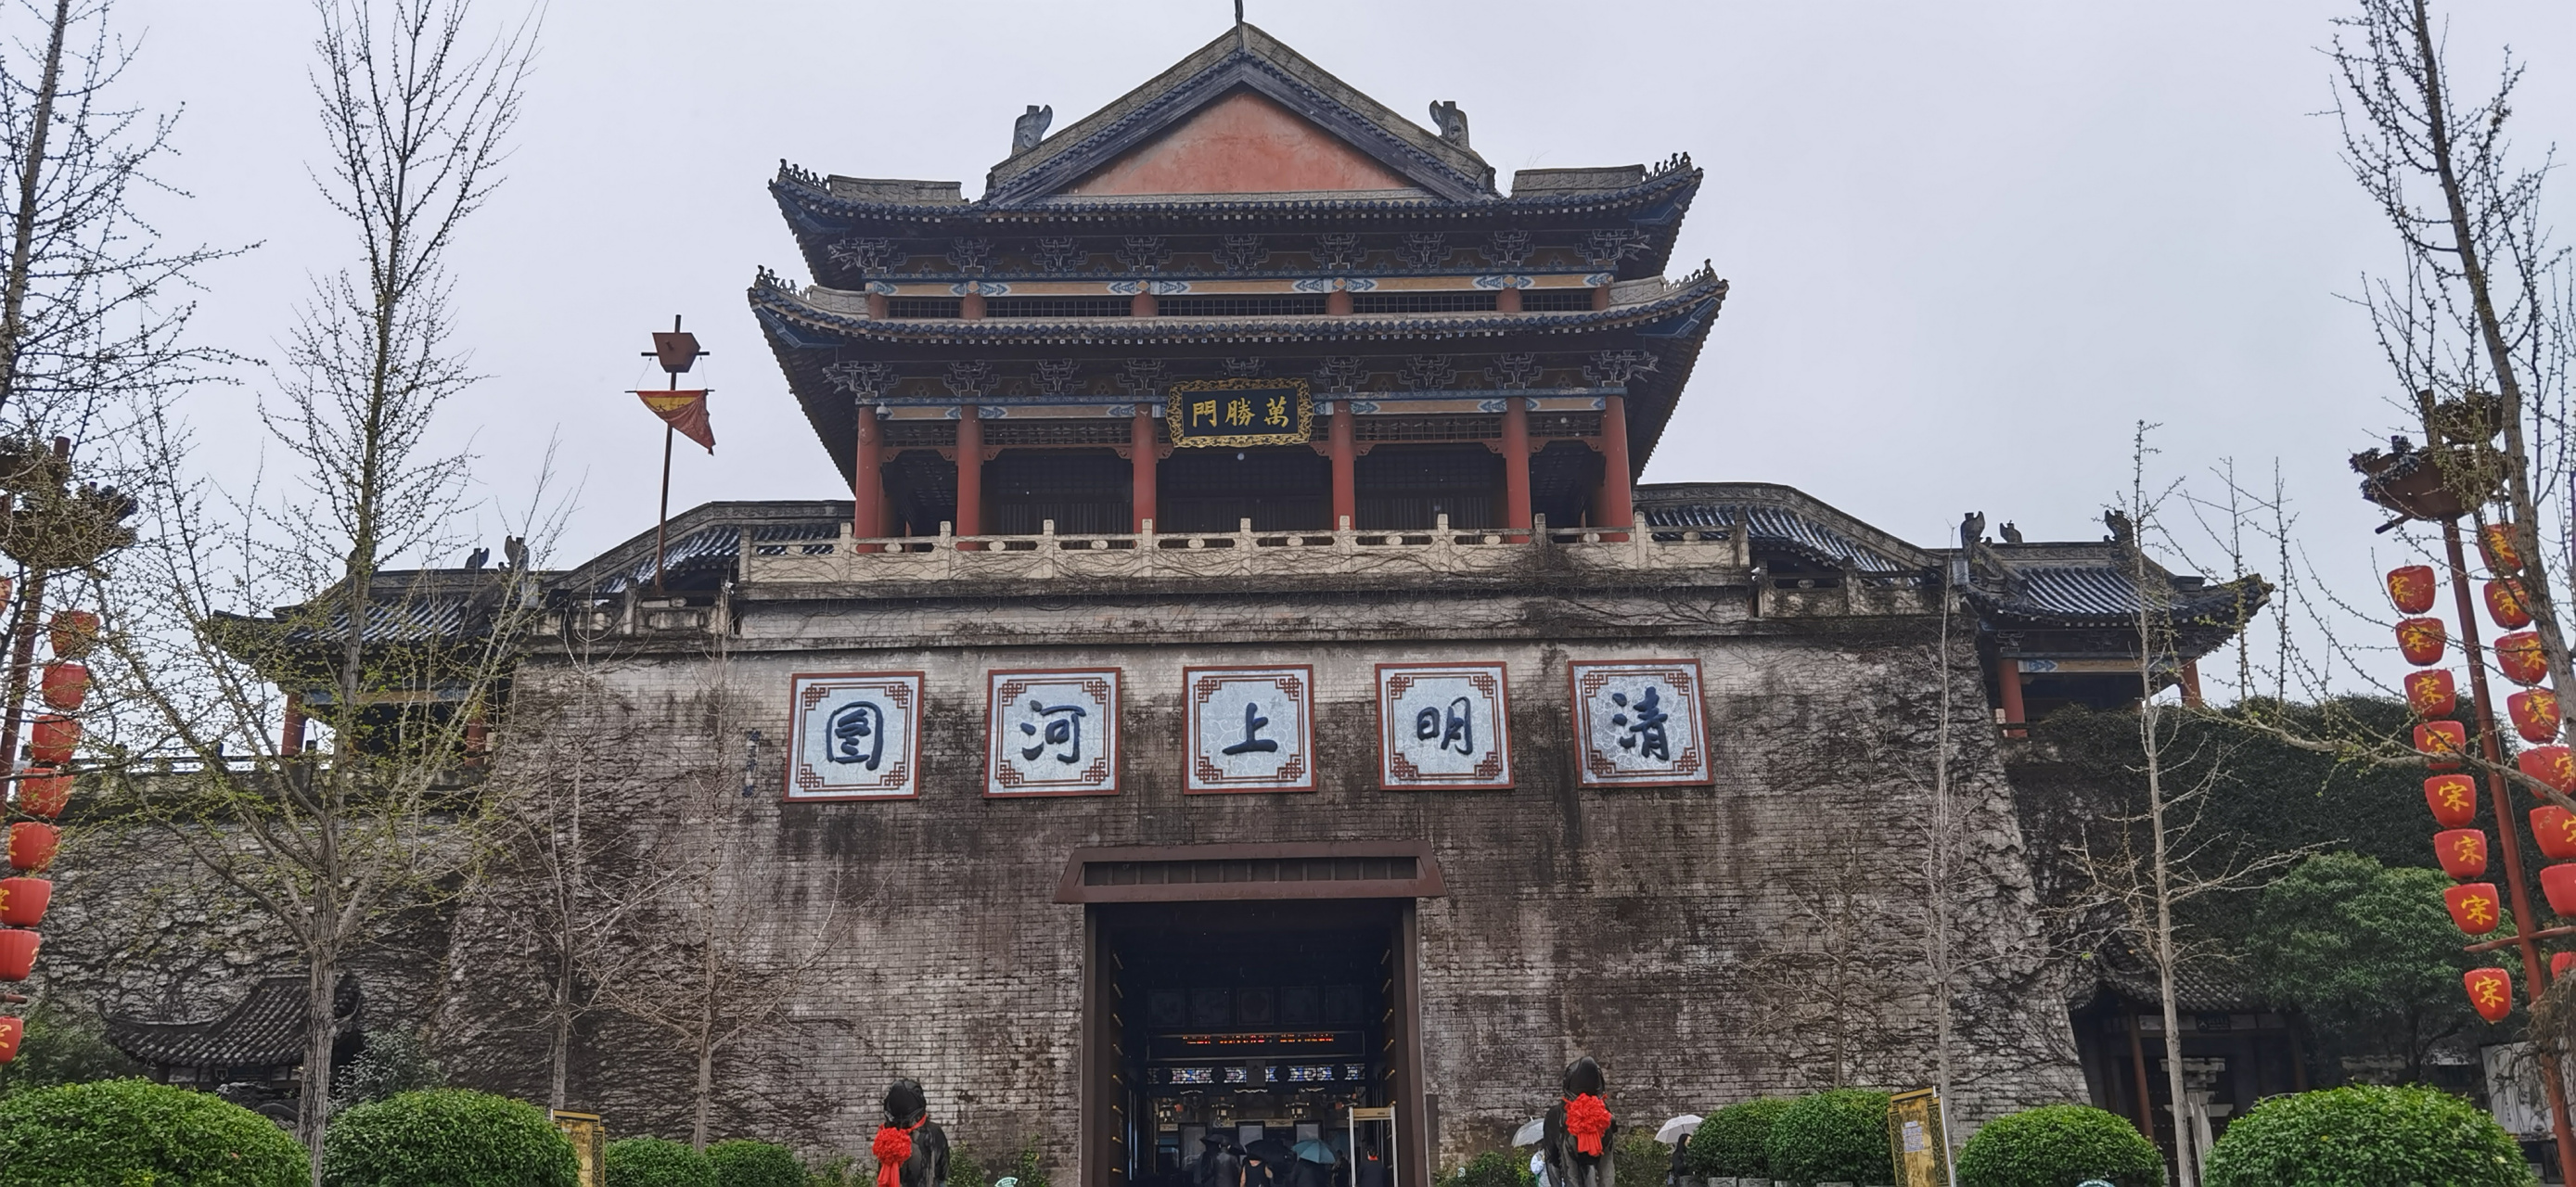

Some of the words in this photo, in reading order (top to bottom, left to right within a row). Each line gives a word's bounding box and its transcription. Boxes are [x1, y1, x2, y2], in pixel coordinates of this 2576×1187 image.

[2415, 677, 2444, 703] 宋
[2439, 781, 2469, 811] 宋
[2454, 836, 2483, 865] 宋
[2461, 894, 2493, 925] 宋
[2474, 976, 2505, 1008] 宋
